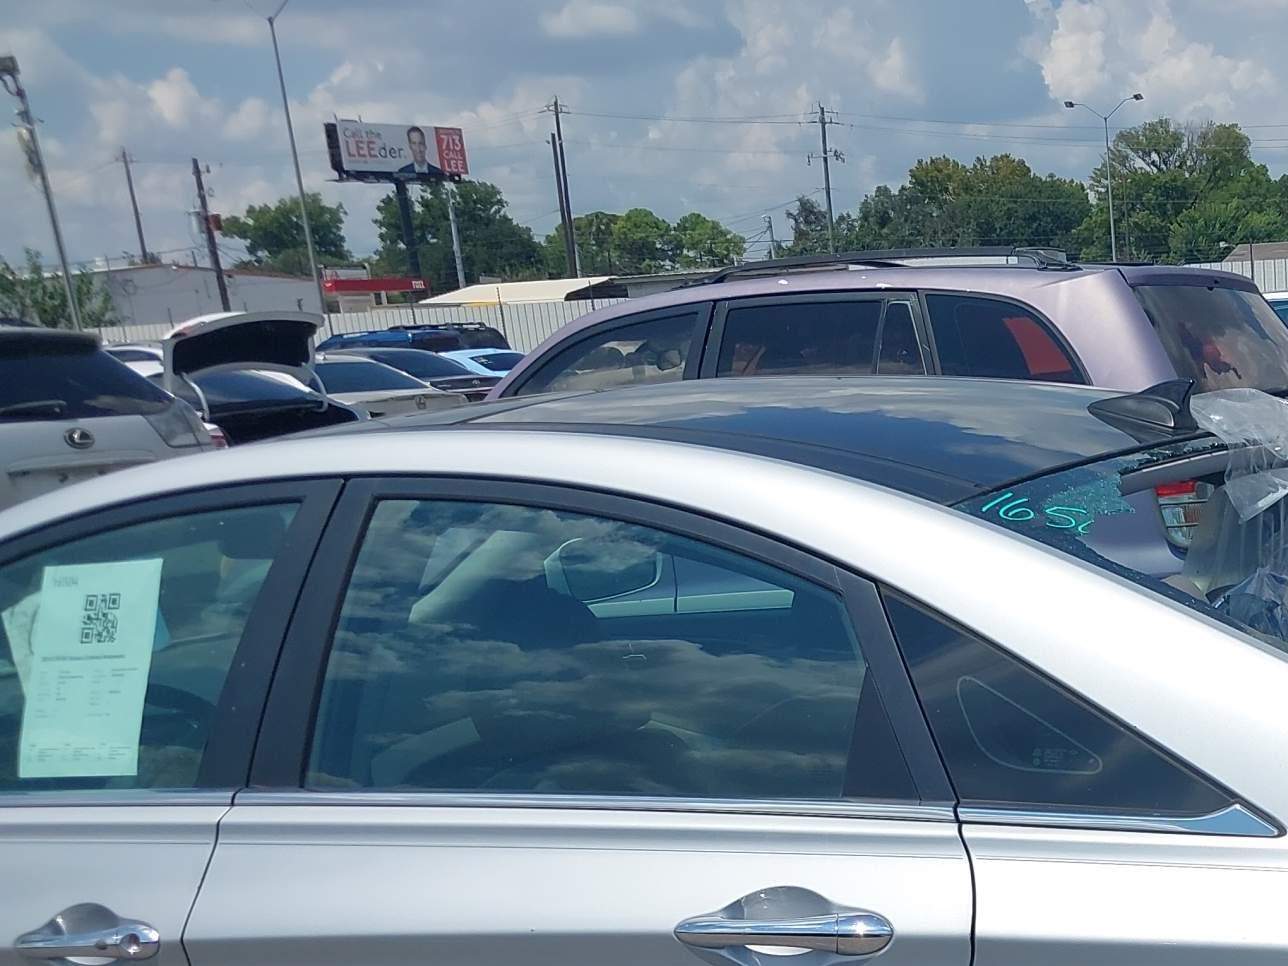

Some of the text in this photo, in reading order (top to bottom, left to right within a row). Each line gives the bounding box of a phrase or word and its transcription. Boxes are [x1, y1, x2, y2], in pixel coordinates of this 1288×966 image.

[439, 134, 462, 150] 713
[442, 150, 464, 160] CALL
[444, 159, 466, 173] LEE
